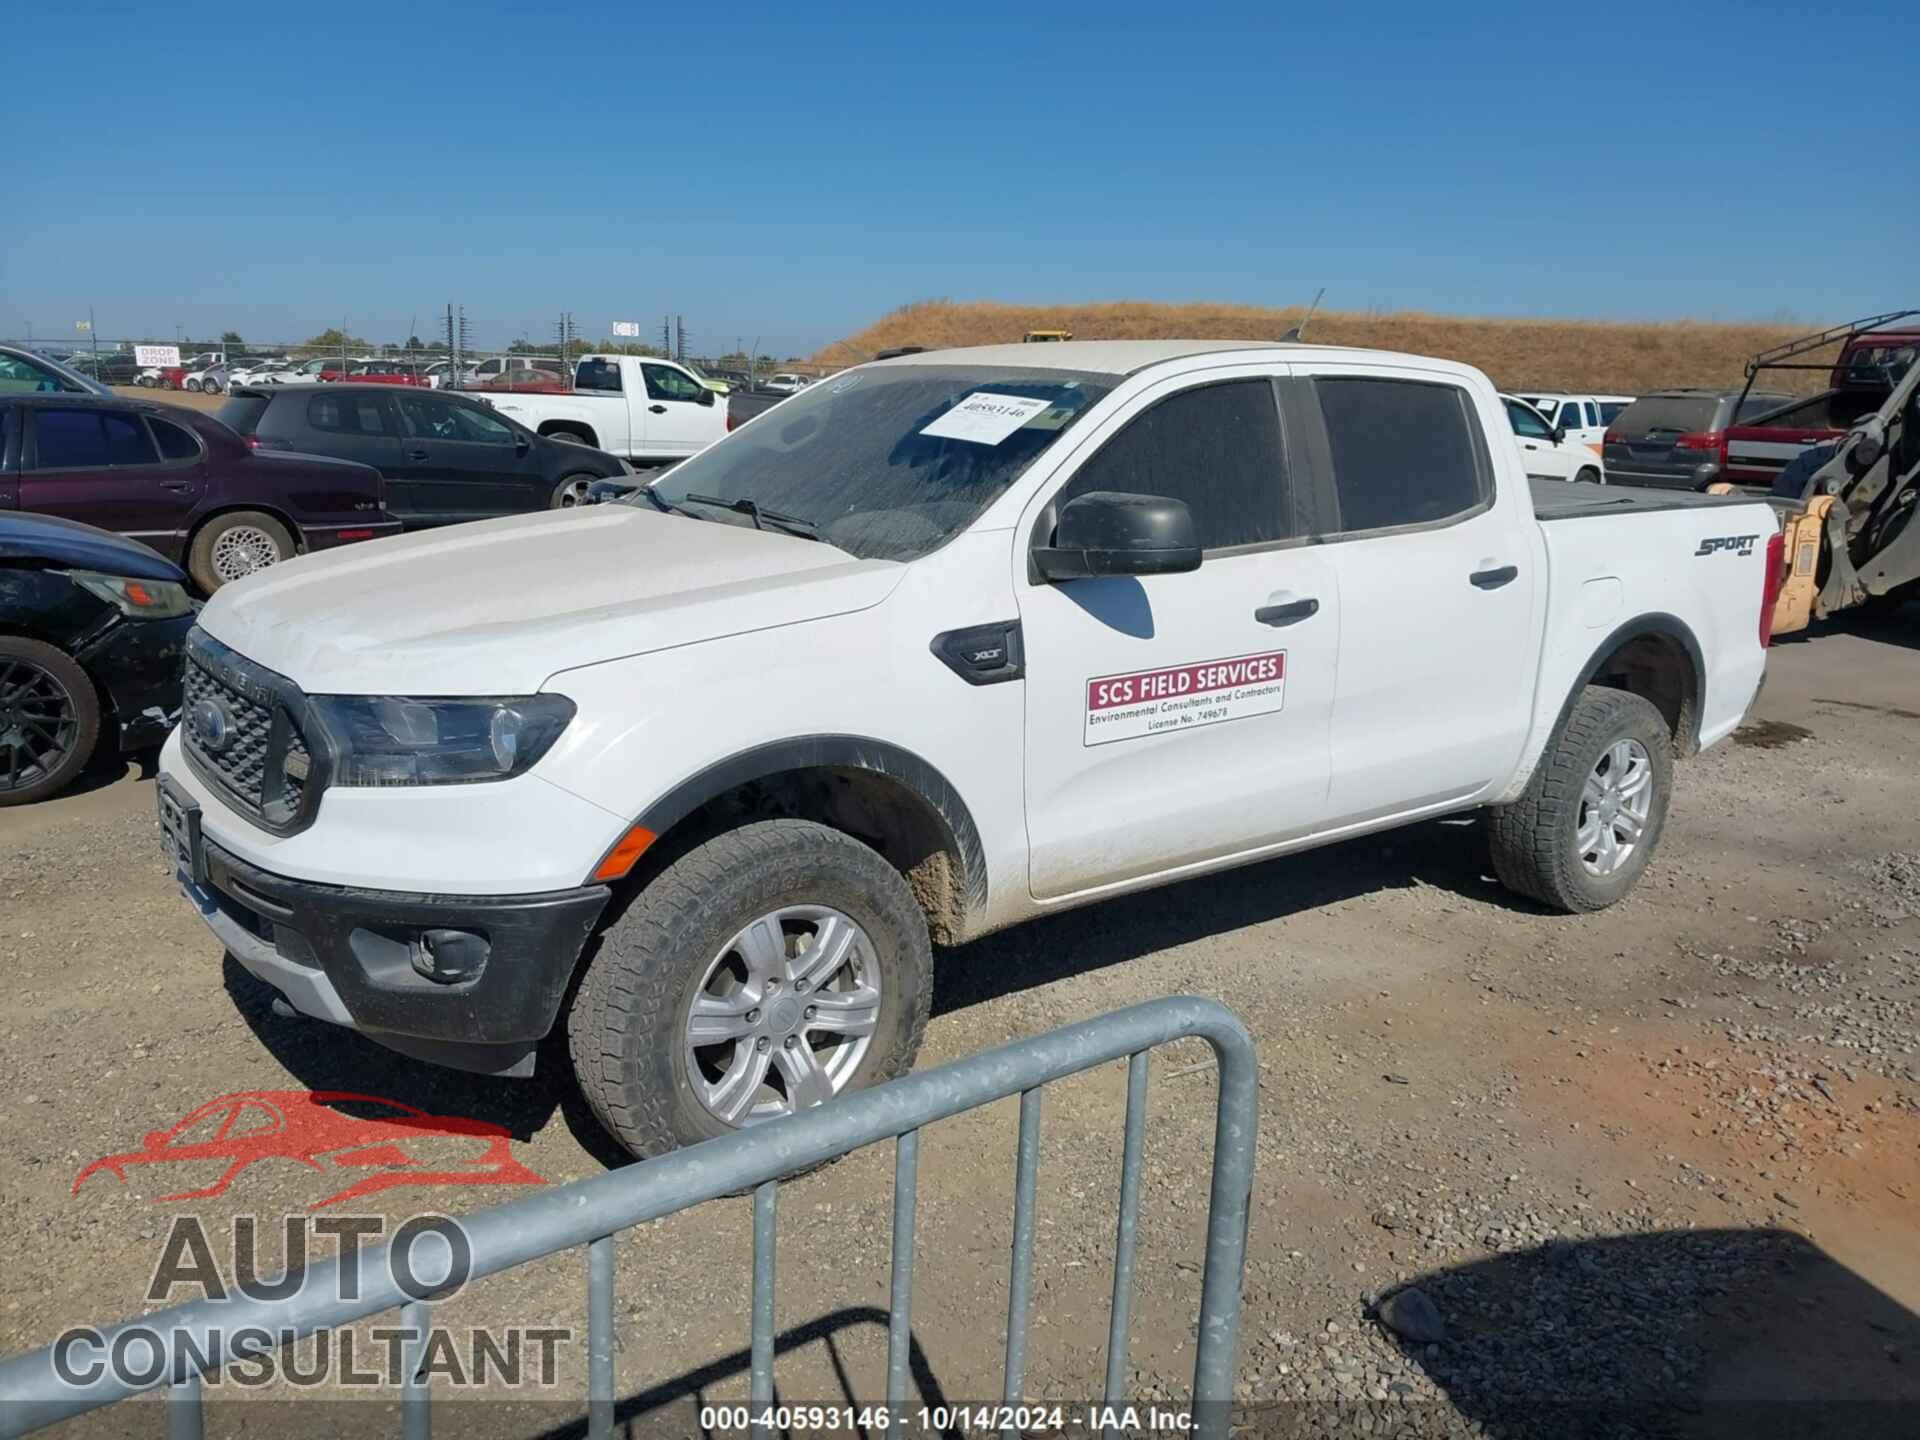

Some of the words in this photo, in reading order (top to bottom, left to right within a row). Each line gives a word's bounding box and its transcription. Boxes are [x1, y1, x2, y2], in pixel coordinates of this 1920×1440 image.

[141, 347, 174, 356] DROP
[142, 356, 176, 365] ZONE
[1694, 534, 1760, 556] SPORT
[974, 648, 1002, 661] XLT
[1098, 680, 1133, 705] SCS
[1140, 672, 1190, 698] FIELD
[1196, 658, 1277, 689] SERVICES
[1088, 703, 1158, 726] Environmental
[1160, 697, 1213, 713] Consultants
[1215, 693, 1232, 703] and
[1234, 684, 1281, 700] Contractors
[1148, 715, 1178, 730] License
[1180, 713, 1195, 724] No.
[1197, 707, 1228, 720] 749678
